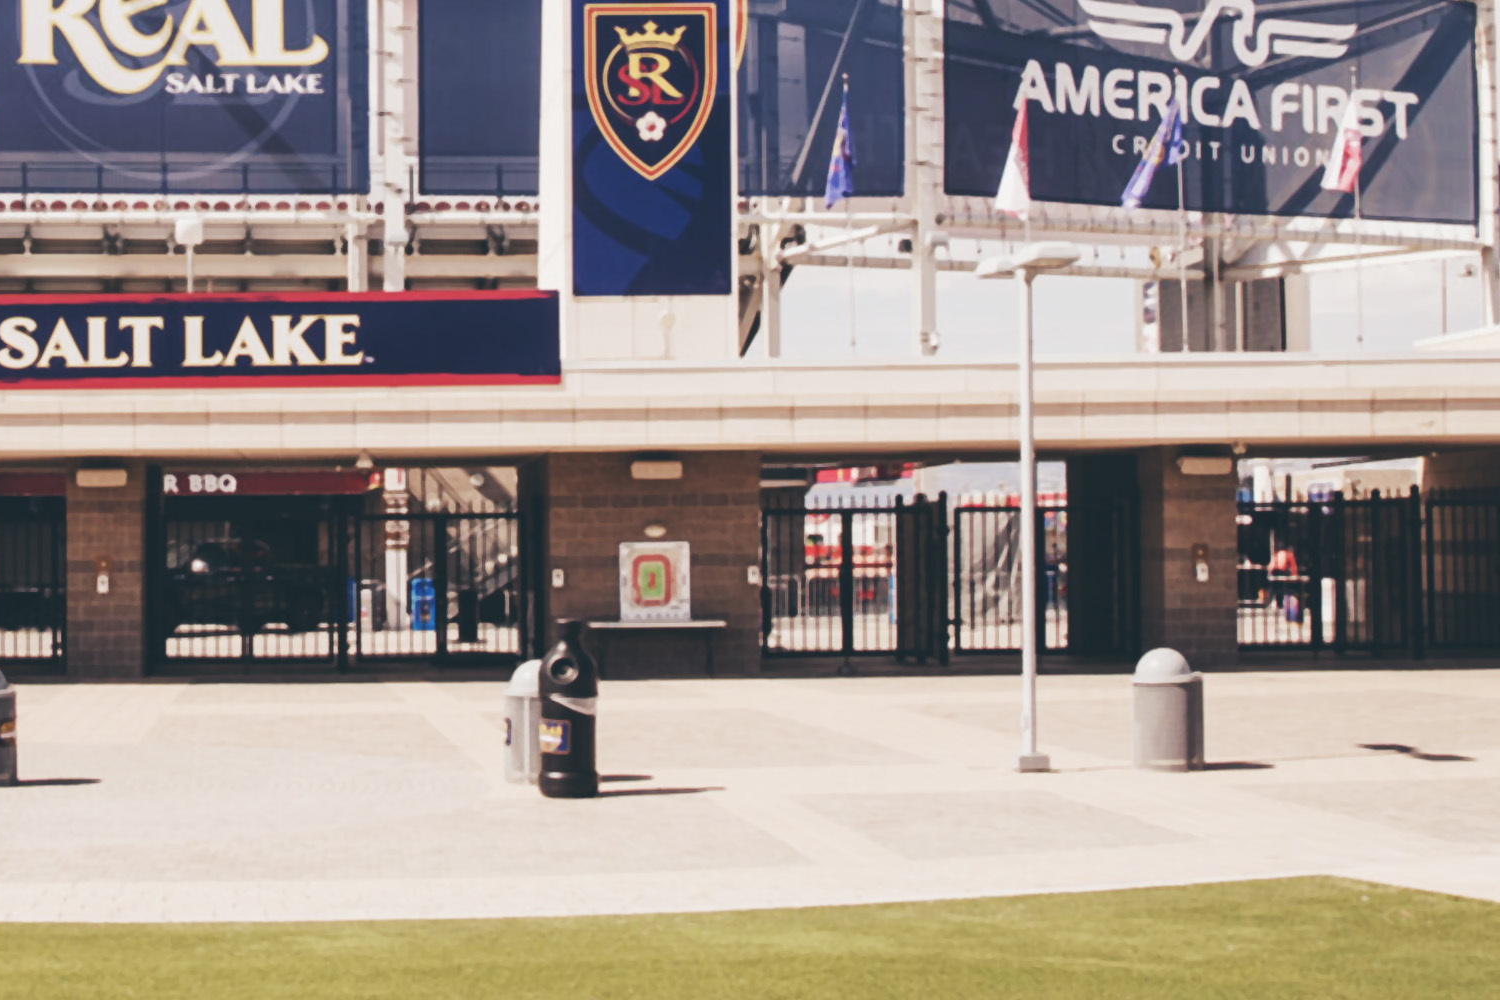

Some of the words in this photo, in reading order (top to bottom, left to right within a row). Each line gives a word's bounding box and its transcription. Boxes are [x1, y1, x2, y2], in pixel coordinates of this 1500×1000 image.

[165, 72, 240, 96] SALT
[246, 72, 325, 96] LAKE
[1013, 59, 1261, 130] AMERICA
[1271, 82, 1419, 140] FIRST
[1112, 134, 1222, 161] CRDIT
[1240, 144, 1331, 168] UNION
[183, 314, 366, 369] LAKE
[188, 474, 237, 494] BBQ
